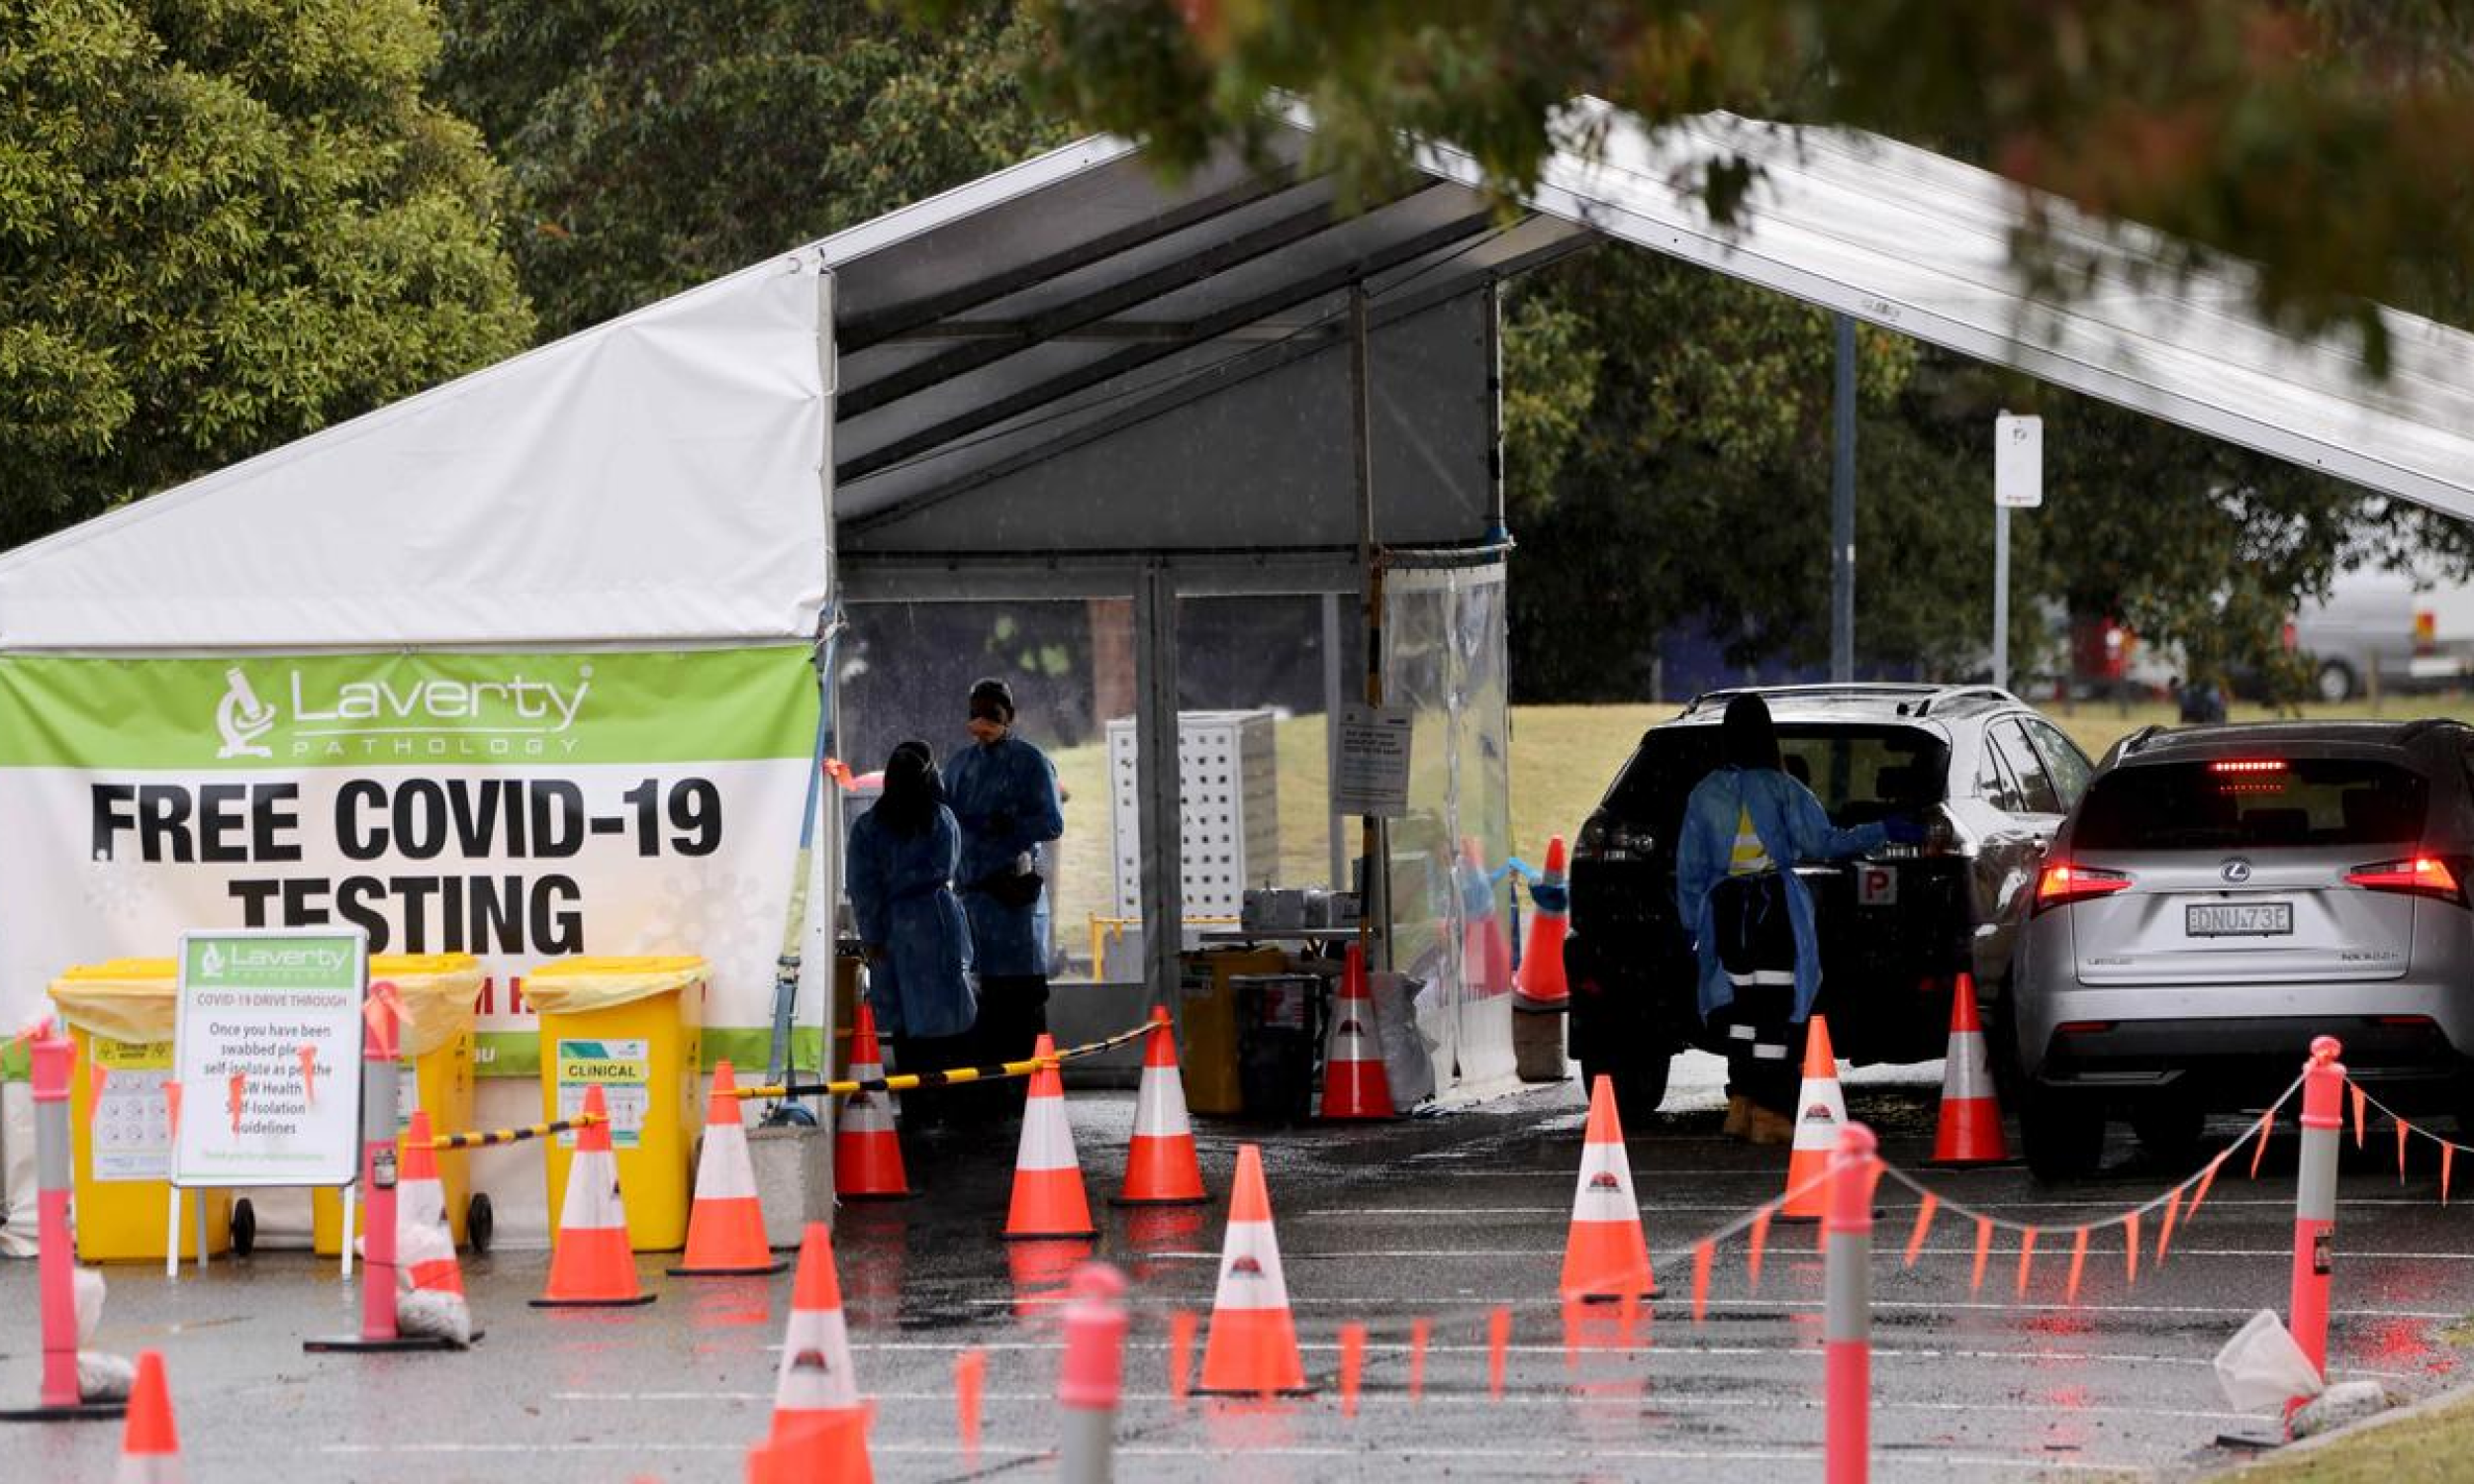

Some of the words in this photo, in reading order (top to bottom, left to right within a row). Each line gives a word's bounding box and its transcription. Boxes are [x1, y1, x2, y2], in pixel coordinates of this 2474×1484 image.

[290, 669, 590, 733] Laverty
[292, 738, 578, 758] PATHOLOGY
[91, 783, 302, 863] FREE
[334, 778, 723, 862] COVID-19
[1865, 870, 1890, 899] P
[229, 874, 584, 955] TESTING
[231, 943, 351, 972] Laverty
[197, 993, 250, 1007] COVID-19
[253, 994, 287, 1007] DRIVE
[290, 994, 347, 1007] THROUGH
[210, 1022, 240, 1037] Once
[243, 1025, 267, 1039] you
[269, 1022, 298, 1037] have
[300, 1022, 331, 1038] been
[222, 1041, 276, 1056] swabbed
[313, 1063, 333, 1075] the
[568, 1065, 636, 1076] CLINICAL
[262, 1082, 303, 1095] Health
[226, 1101, 306, 1115] Slf-Isolation
